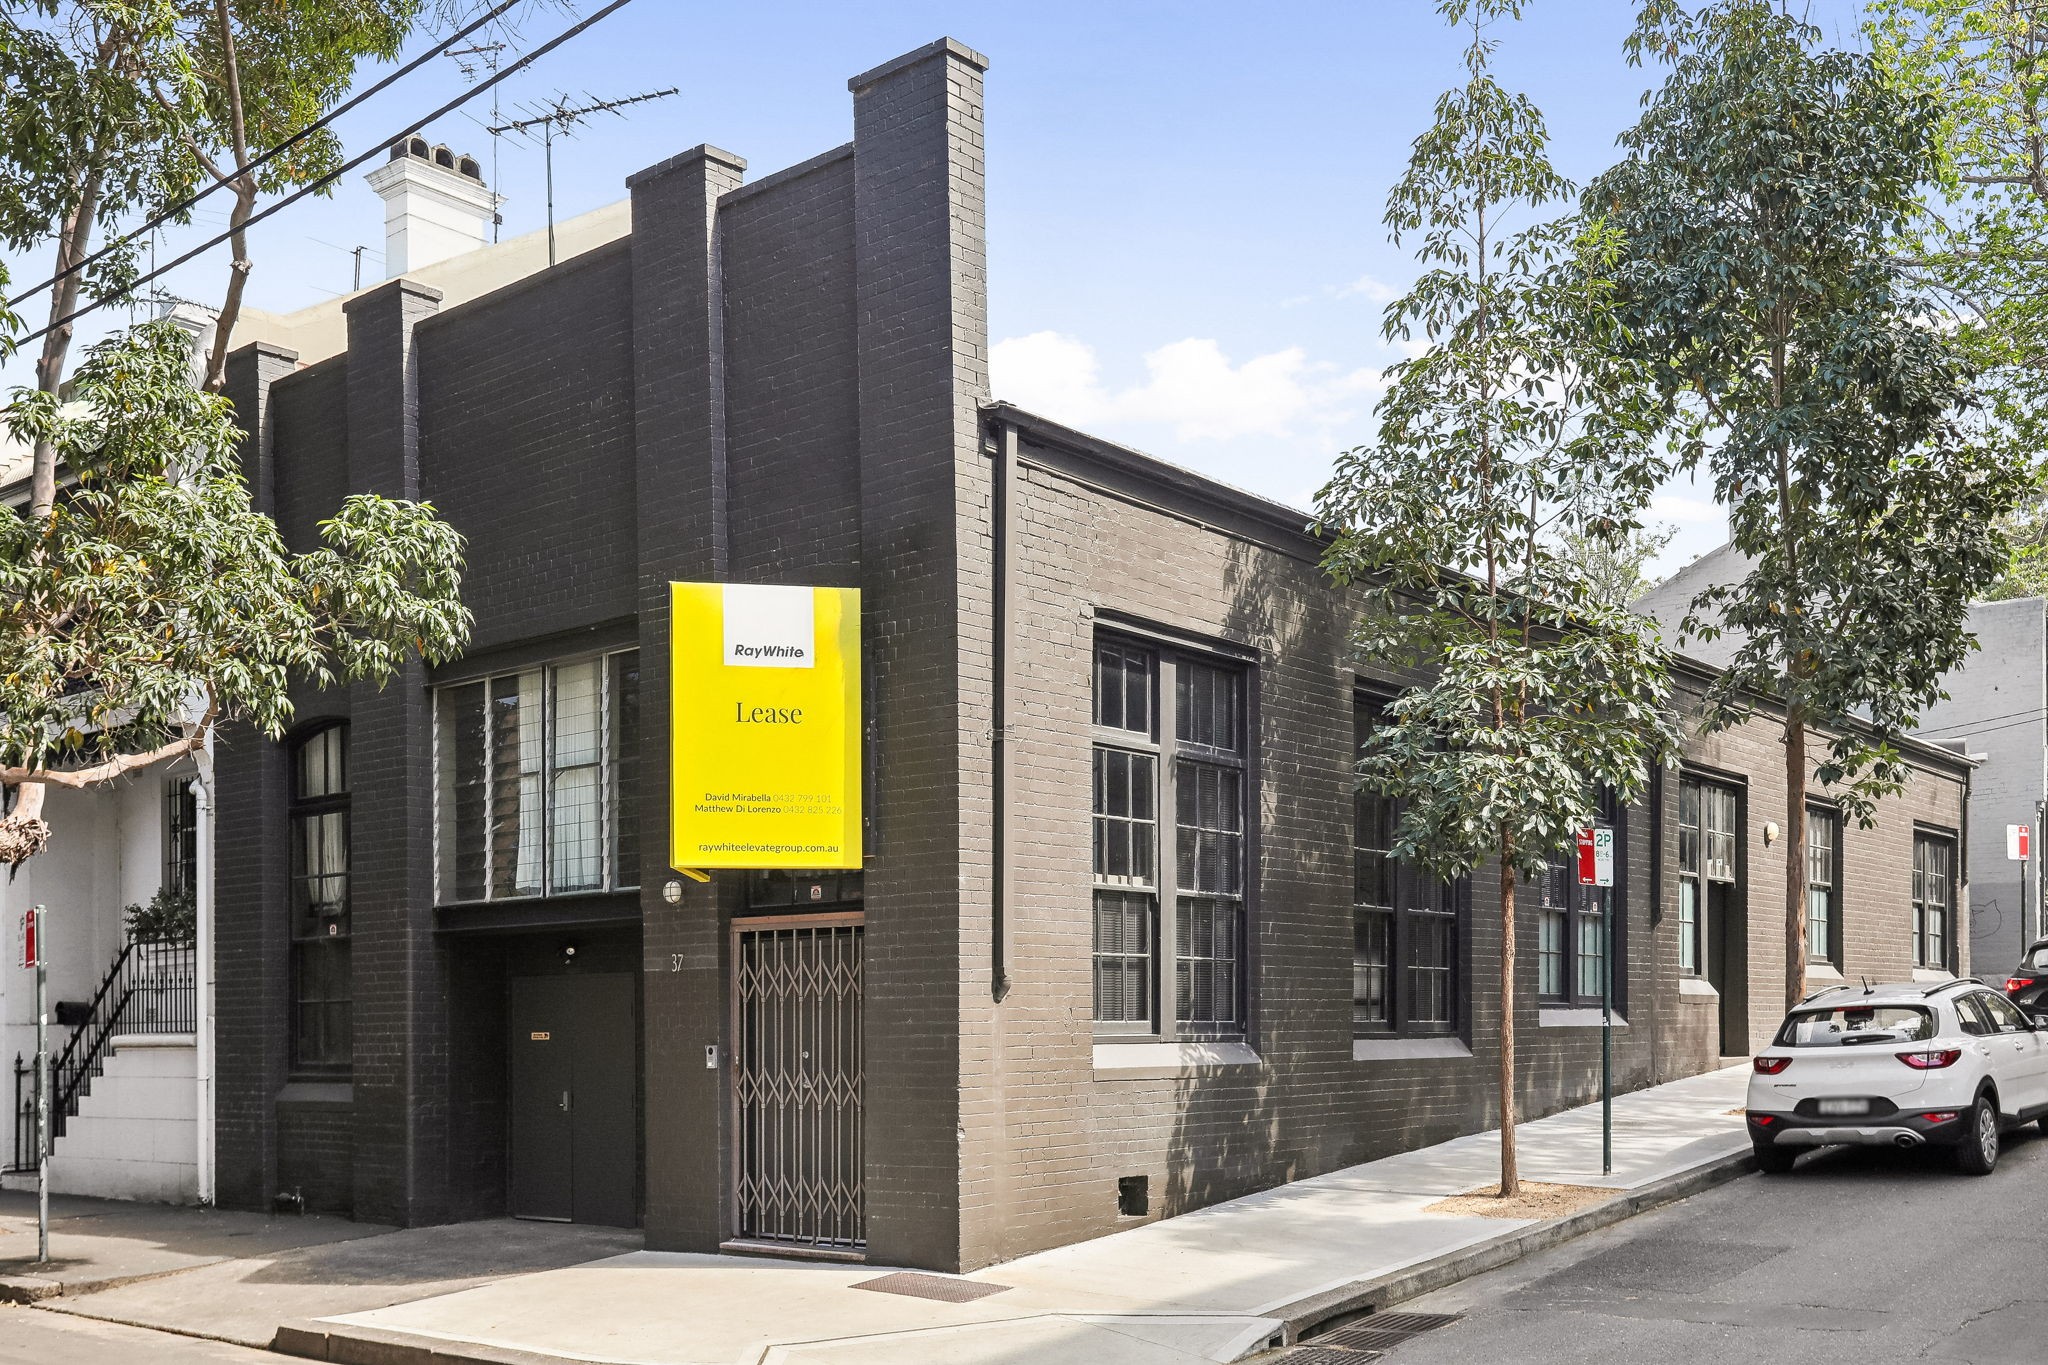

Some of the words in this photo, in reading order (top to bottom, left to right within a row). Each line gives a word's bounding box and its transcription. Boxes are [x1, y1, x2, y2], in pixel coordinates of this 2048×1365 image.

[735, 644, 804, 659] RayWhite
[735, 701, 803, 724] Lease
[705, 793, 730, 802] David
[732, 793, 771, 802] Mirabella
[772, 794, 795, 802] 0432
[798, 794, 814, 803] 799
[817, 794, 832, 803] 101
[694, 804, 734, 813] Matthew
[736, 804, 746, 813] Di
[747, 805, 782, 813] Lorenzo
[783, 805, 805, 814] 0432
[807, 806, 824, 814] 825
[826, 806, 842, 815] 226
[1596, 833, 1611, 847] 2P
[698, 842, 839, 854] raywhiteelevategroup.com.au
[671, 953, 684, 972] 37
